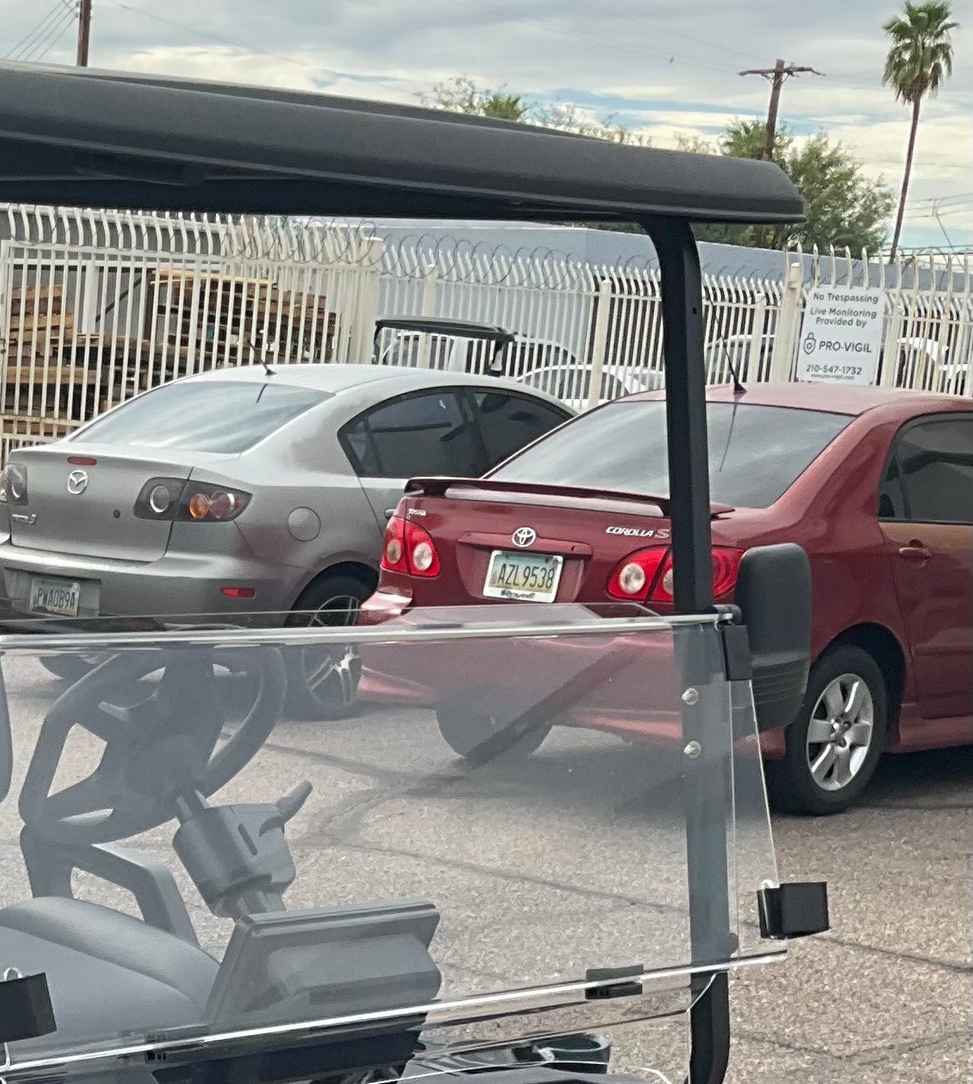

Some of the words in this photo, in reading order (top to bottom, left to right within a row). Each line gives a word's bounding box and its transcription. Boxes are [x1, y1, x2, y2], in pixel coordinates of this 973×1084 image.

[827, 293, 879, 304] Trespassing
[810, 308, 827, 316] Live
[829, 308, 877, 320] Monitoring
[815, 317, 854, 326] Provided
[856, 318, 867, 328] by
[818, 341, 872, 353] PRO-VIGIL
[805, 364, 862, 376] 210-547-1732
[605, 526, 654, 537] COROLLA
[654, 529, 672, 539] S
[497, 563, 556, 589] AZL9538
